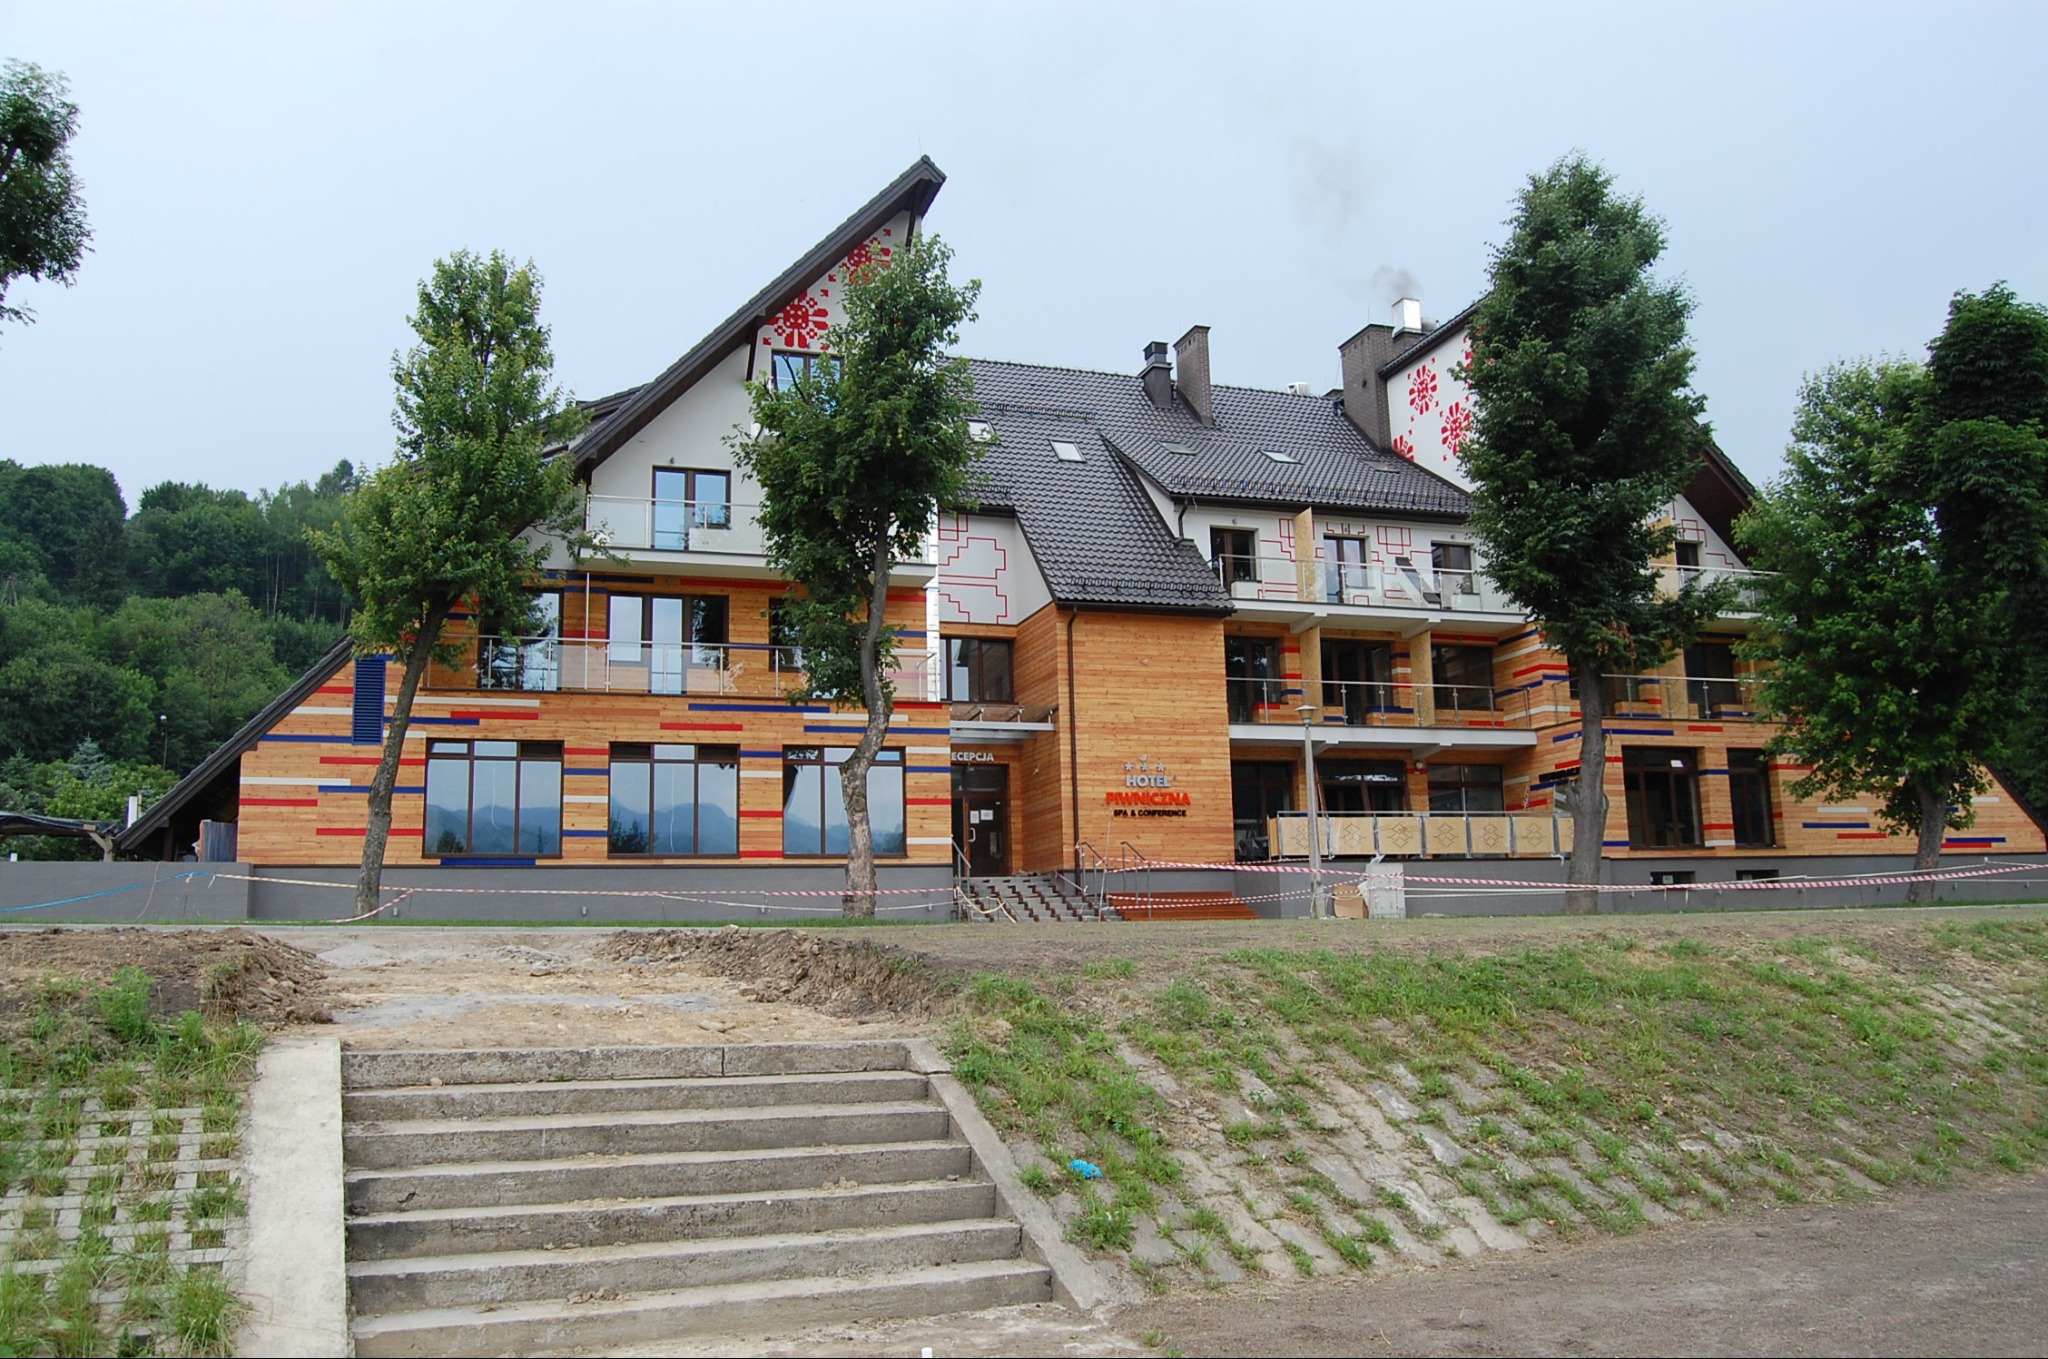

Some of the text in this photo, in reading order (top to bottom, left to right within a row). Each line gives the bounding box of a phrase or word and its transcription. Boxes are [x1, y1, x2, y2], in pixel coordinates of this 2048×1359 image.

[951, 751, 995, 761] ECEPCJA
[1125, 774, 1171, 788] HOTEL
[1105, 791, 1192, 806] PIWNICZNA
[1113, 809, 1187, 817] SPA & CONFERENCE
